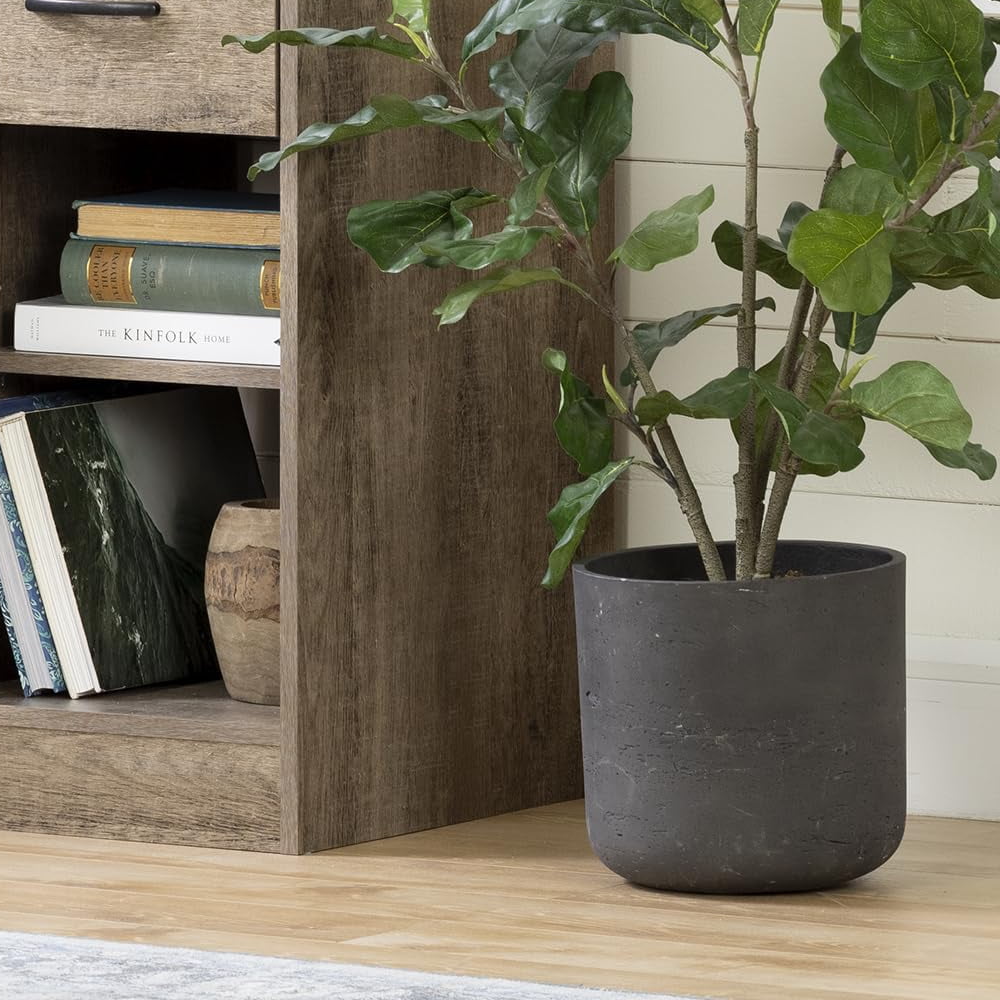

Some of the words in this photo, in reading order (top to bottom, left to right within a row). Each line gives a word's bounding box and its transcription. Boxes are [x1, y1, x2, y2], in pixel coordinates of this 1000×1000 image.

[93, 248, 104, 288] COOLER
[98, 329, 117, 338] THE
[123, 328, 198, 345] KINFOLK
[204, 335, 232, 344] HOME
